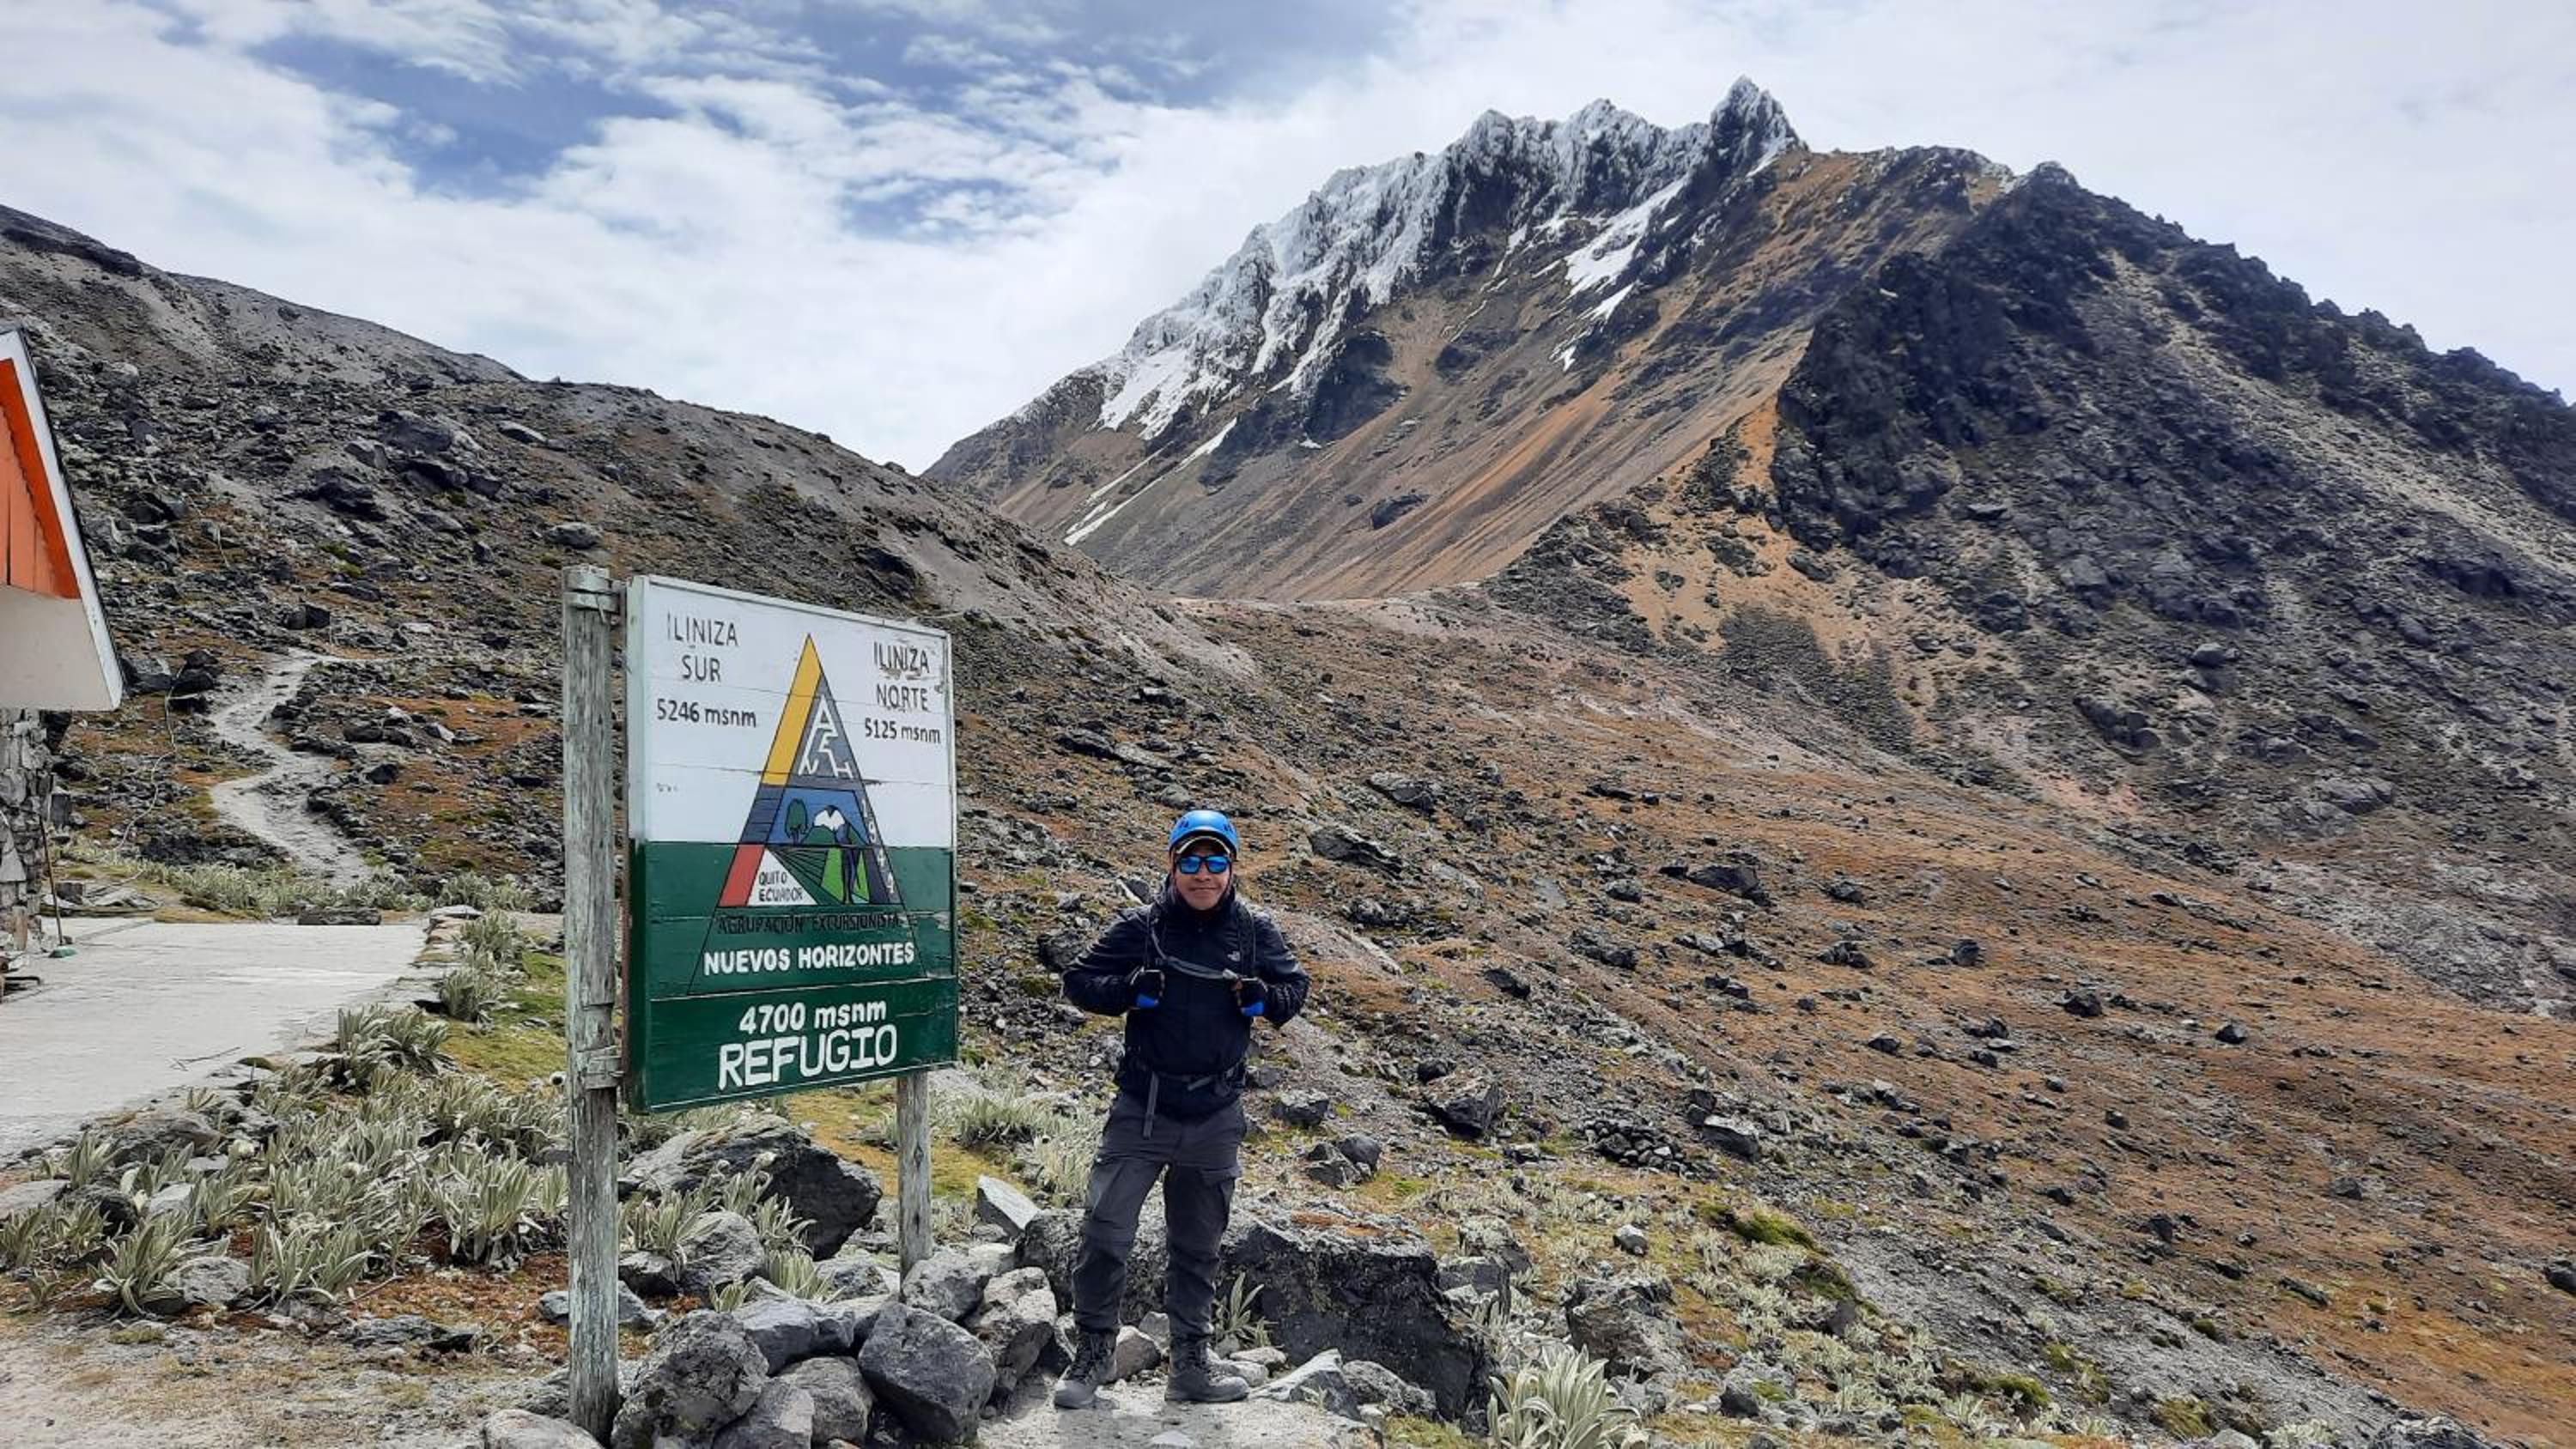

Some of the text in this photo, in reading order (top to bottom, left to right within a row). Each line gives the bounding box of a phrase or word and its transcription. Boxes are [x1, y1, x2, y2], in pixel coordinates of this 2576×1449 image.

[666, 610, 738, 647] ILINIZA
[681, 654, 721, 682] SUR
[873, 641, 929, 675] ILINIZA
[657, 697, 756, 728] 5246 msnm
[876, 683, 929, 712] NORTE
[865, 717, 941, 744] 5125 msnm
[758, 870, 788, 886] QUITO
[758, 886, 804, 902] ECUADOR
[703, 942, 915, 976] NUEVOS HORIZONTES
[738, 1000, 887, 1035] 4700 msnm
[718, 1024, 897, 1090] REFUGIO
